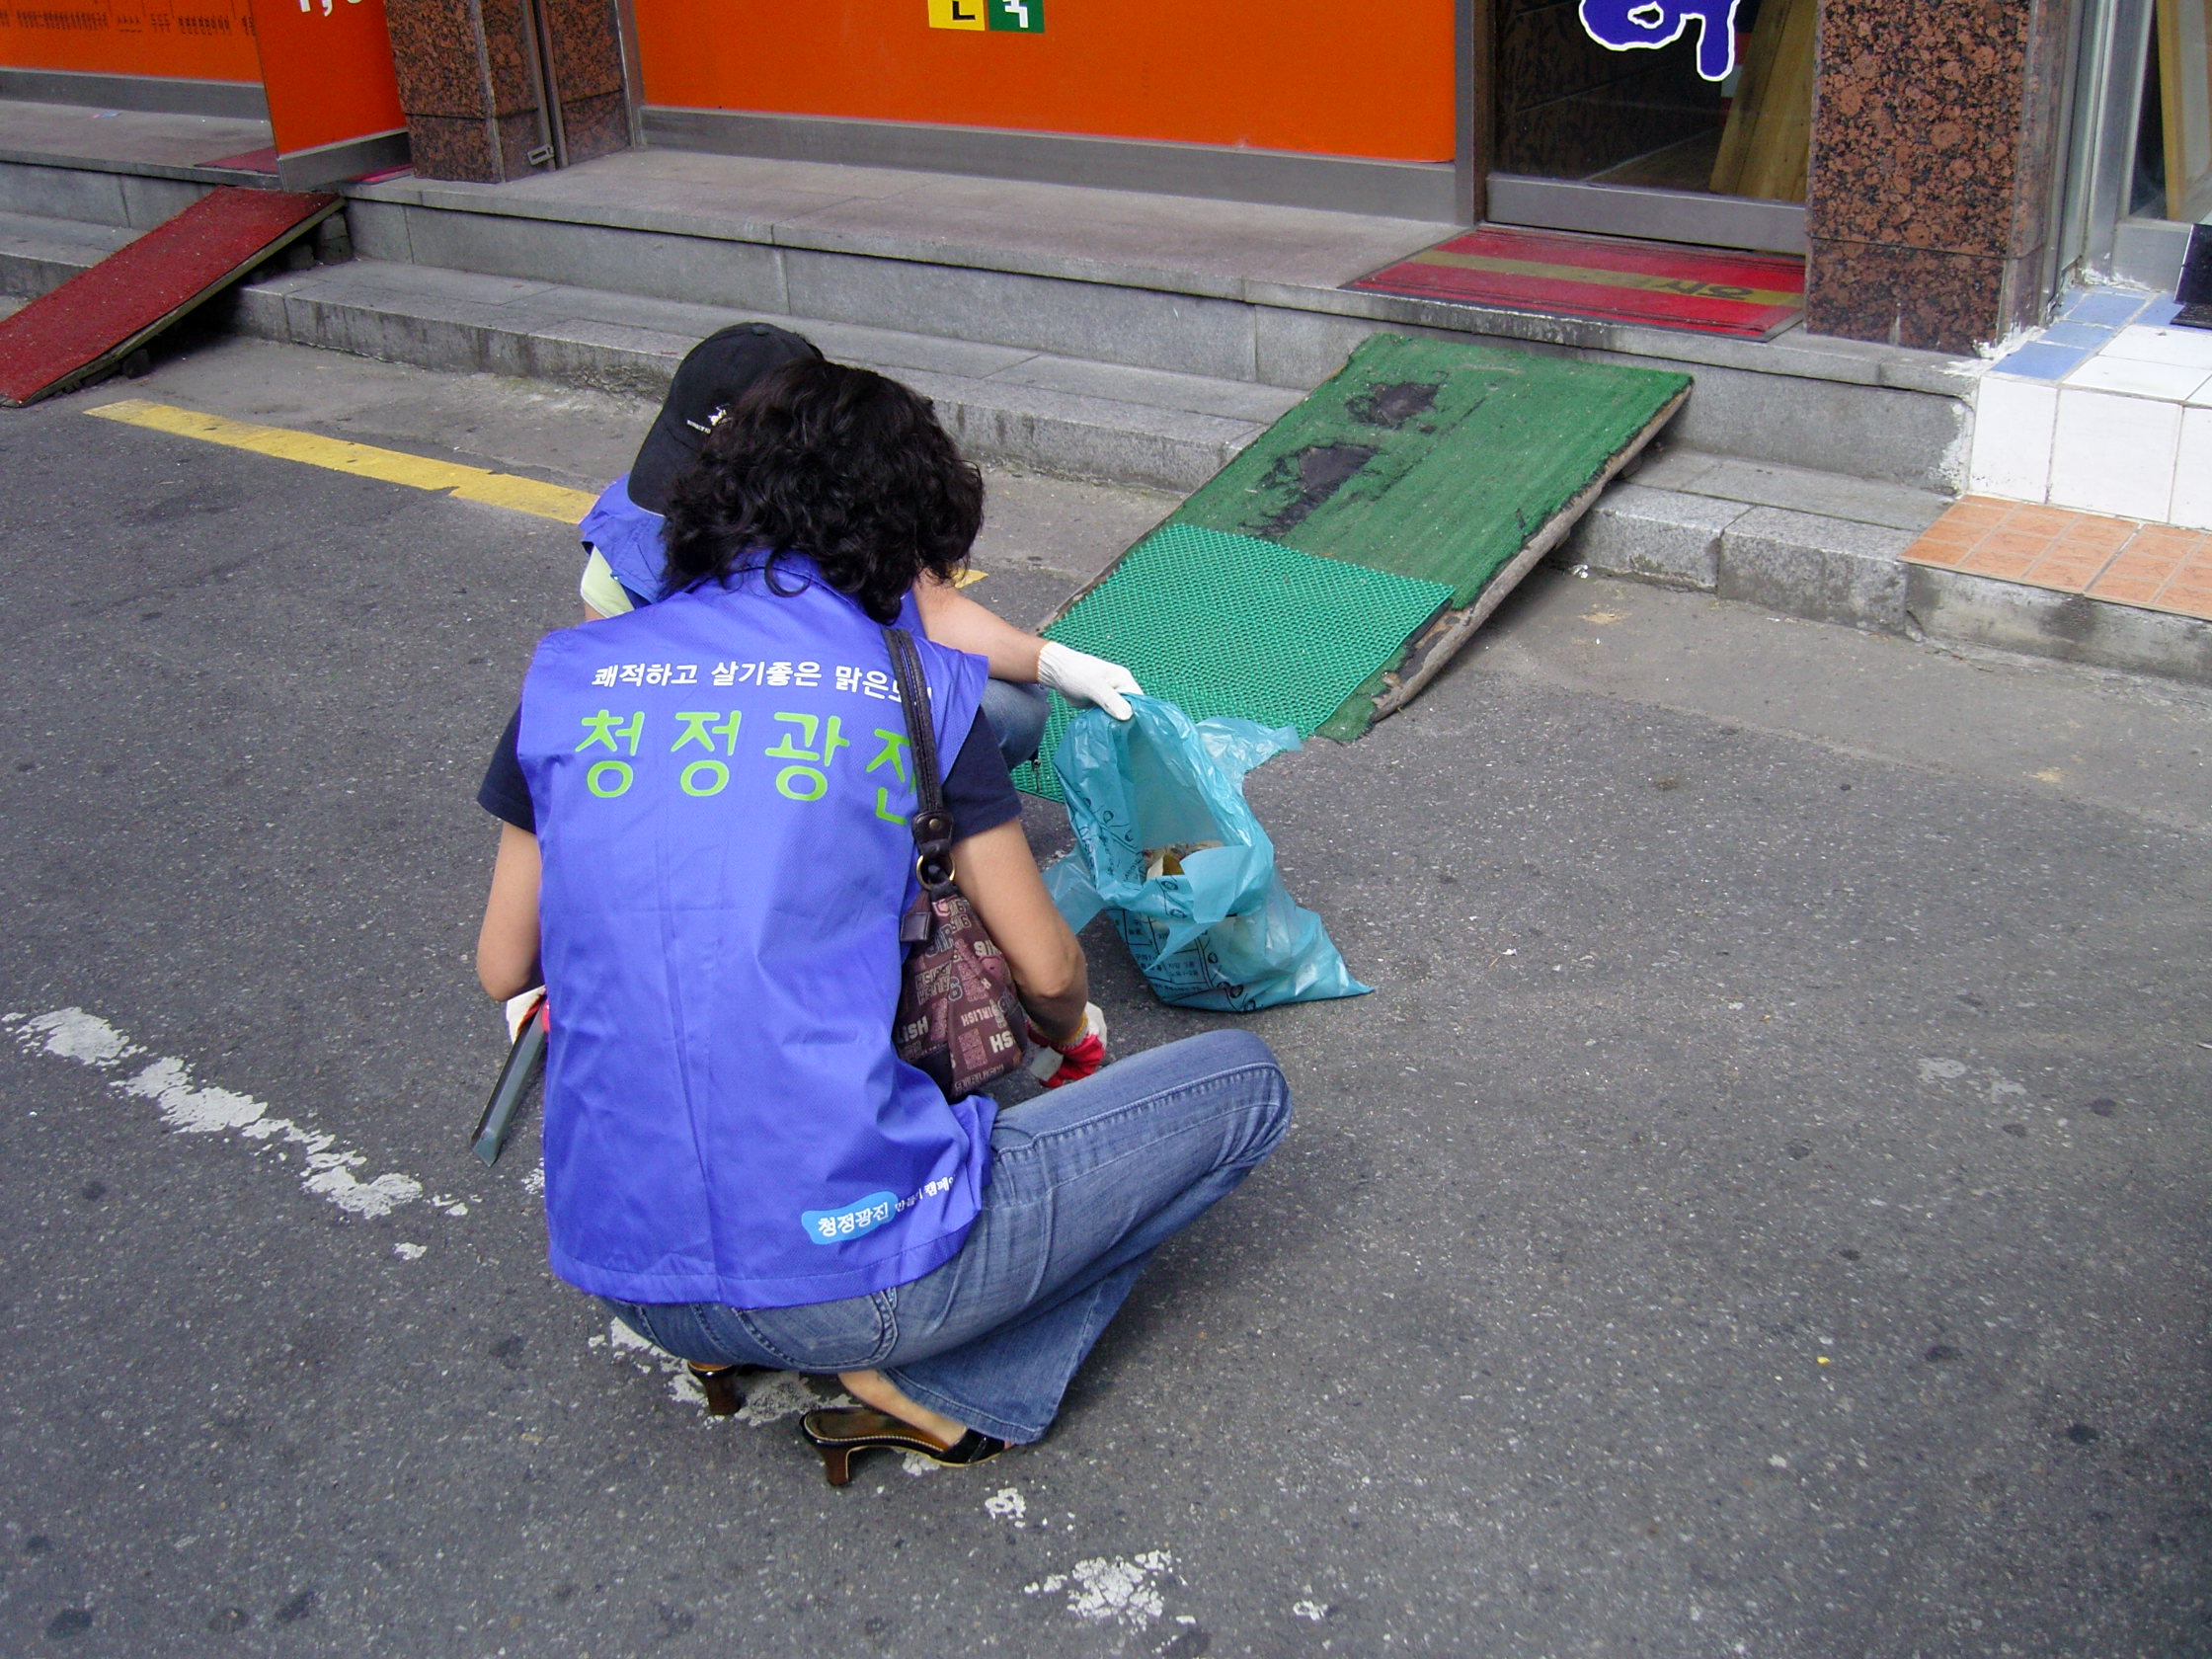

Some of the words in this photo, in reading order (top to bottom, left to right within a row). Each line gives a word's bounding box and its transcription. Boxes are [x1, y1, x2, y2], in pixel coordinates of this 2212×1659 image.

[592, 663, 698, 688] 쾌적하고
[711, 661, 823, 686] 살기좋은
[834, 665, 931, 703] 맑은
[818, 1201, 889, 1237] 청정광진
